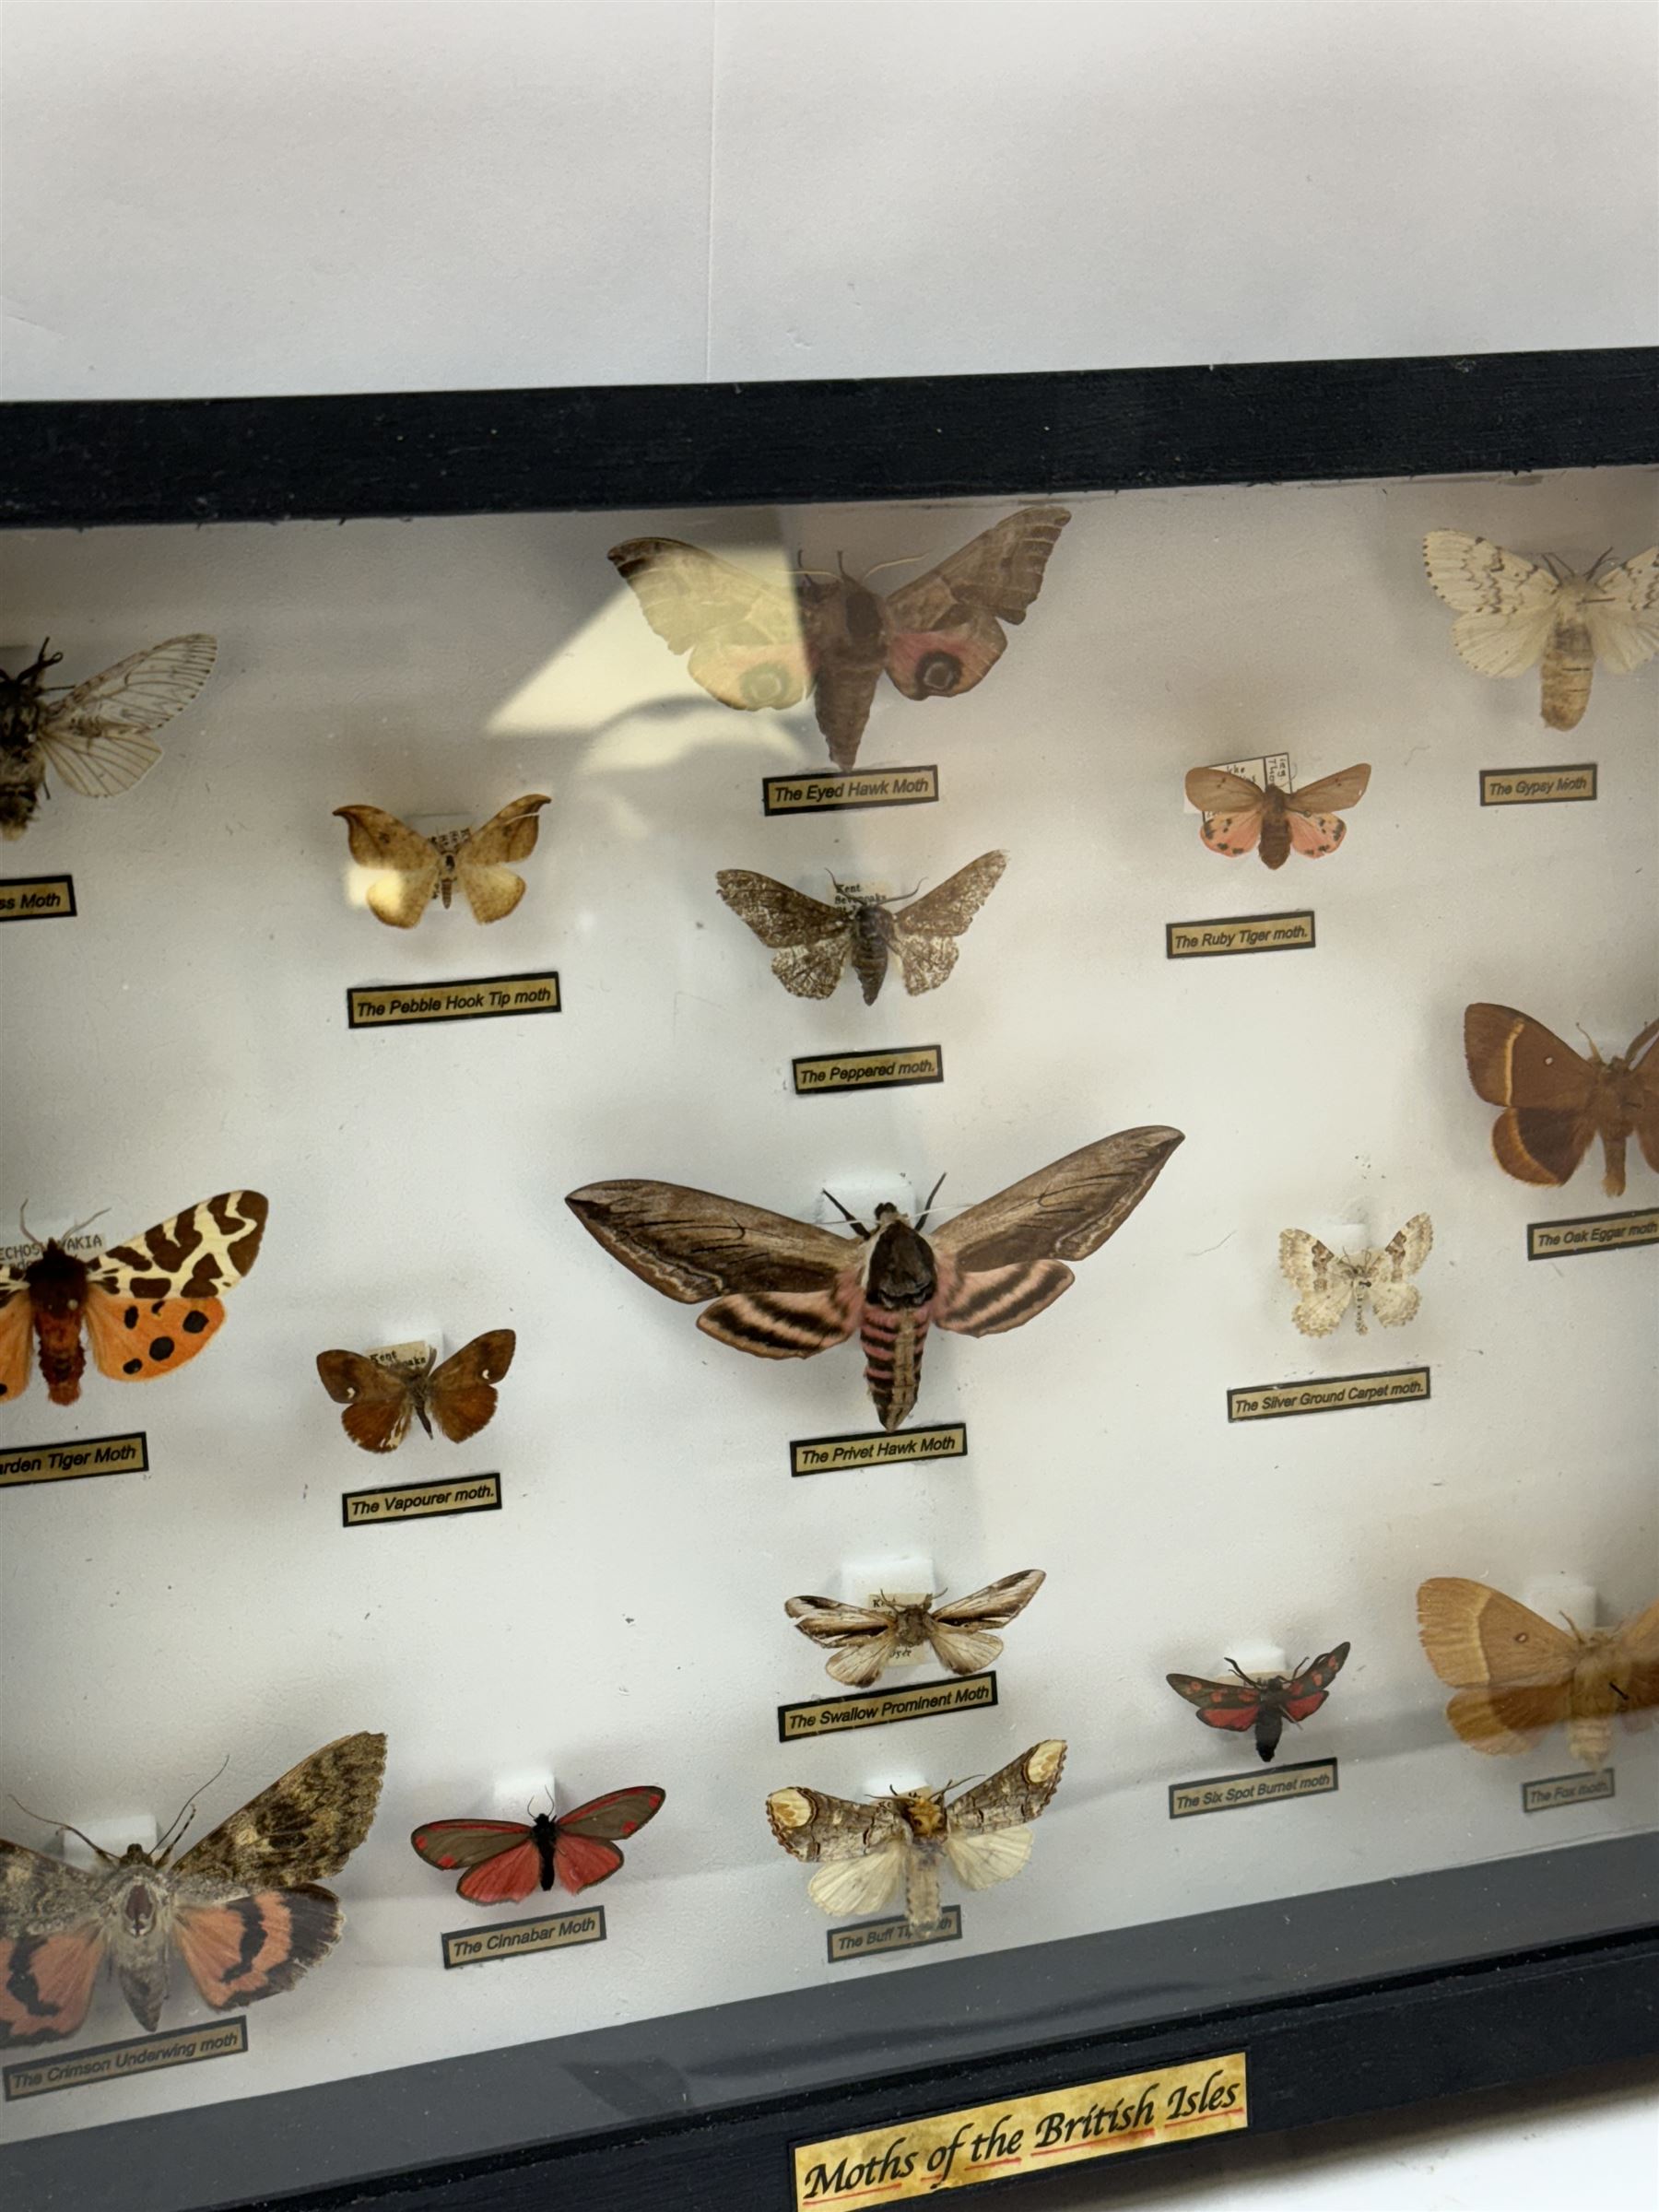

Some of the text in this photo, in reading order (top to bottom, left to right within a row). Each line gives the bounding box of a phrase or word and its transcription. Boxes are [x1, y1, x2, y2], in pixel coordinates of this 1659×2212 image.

[775, 778, 929, 802] The Eyed Hawk Moth
[1489, 776, 1587, 795] The Gypsy Moth
[20, 892, 61, 909] Moth
[1175, 925, 1307, 948] The Ruby Tiger moth.
[358, 987, 551, 1017] The Pebble Hook Tip moth
[801, 1059, 935, 1084] The Peppered moth.
[1538, 1235, 1560, 1247] The
[1563, 1230, 1589, 1243] Oak
[1591, 1227, 1627, 1241] Eggar
[1235, 1381, 1424, 1413] The Silver Ground Carpet moth.
[48, 1453, 91, 1470] Tiger
[94, 1445, 136, 1463] Moth
[802, 1436, 955, 1465] The Privet Hawk Moth
[351, 1485, 495, 1515] The Vapourer moth.
[789, 1686, 989, 1729] The Swallow Prominent Moth
[1177, 1773, 1330, 1809] The Six Spot Burnet moth
[453, 1917, 595, 1957] The Cinnabar Moth
[839, 1936, 863, 1950] The
[866, 1926, 894, 1945] Buff
[14, 2032, 238, 2089] The Crimson Underwing moth
[804, 2070, 1241, 2199] Moths of the British Isles
